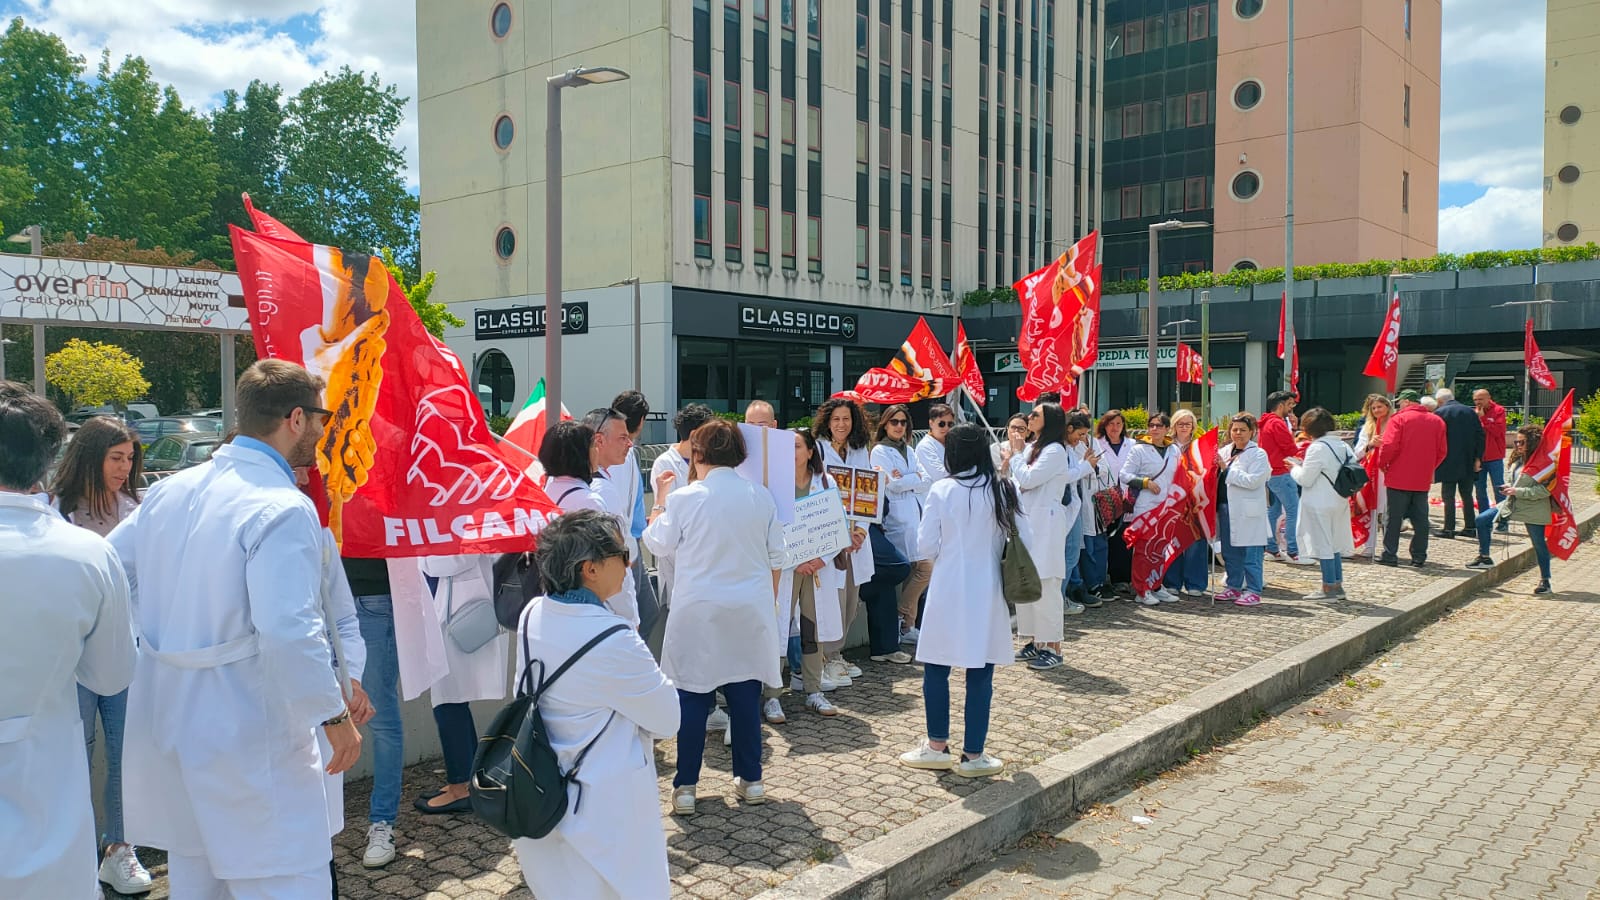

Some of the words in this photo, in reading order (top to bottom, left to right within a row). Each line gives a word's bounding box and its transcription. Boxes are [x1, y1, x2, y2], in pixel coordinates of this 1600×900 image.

[15, 274, 129, 299] overfin
[179, 276, 219, 287] LEASING
[143, 286, 219, 299] FINANZIAMENTI
[15, 295, 54, 306] credit
[59, 297, 90, 307] point
[189, 302, 219, 311] MUTUI
[742, 307, 840, 330] CLASSICO
[1098, 350, 1130, 360] PEDIA
